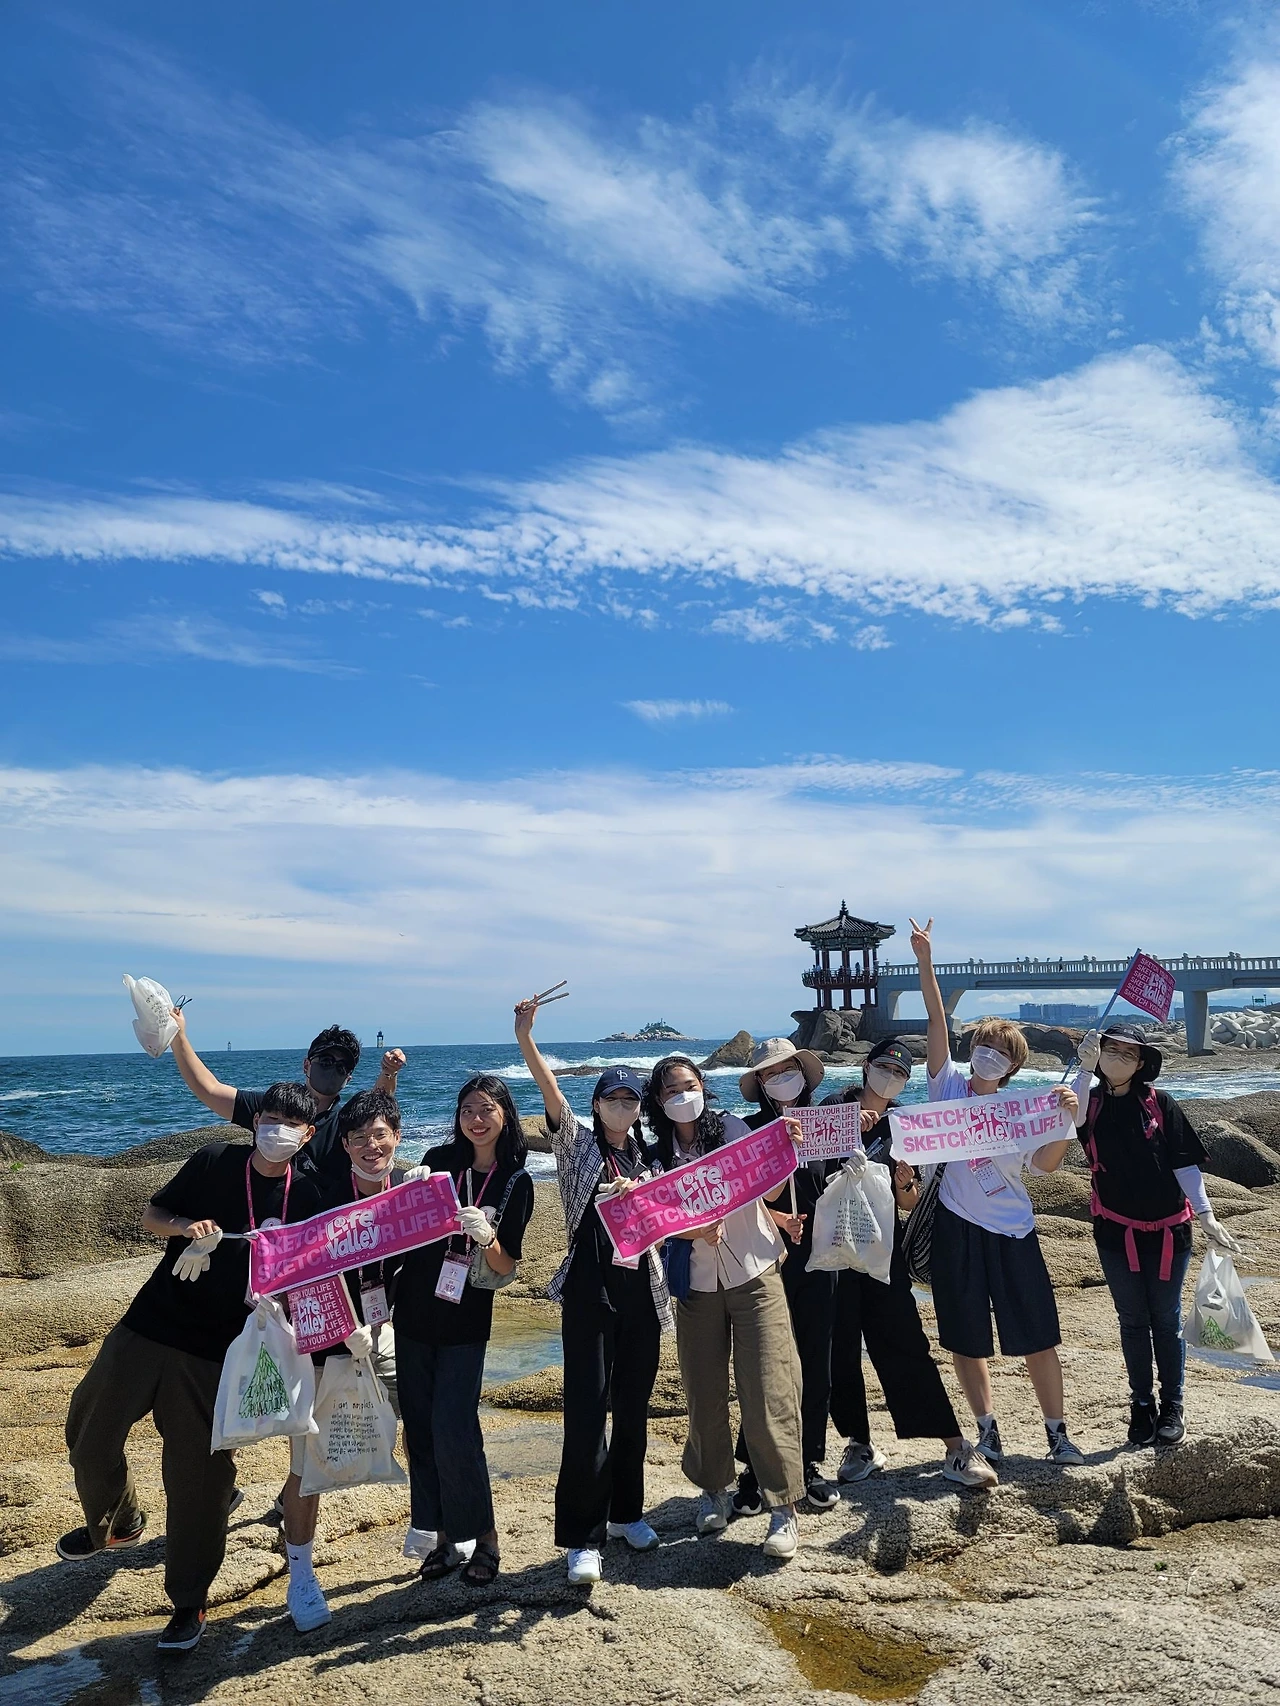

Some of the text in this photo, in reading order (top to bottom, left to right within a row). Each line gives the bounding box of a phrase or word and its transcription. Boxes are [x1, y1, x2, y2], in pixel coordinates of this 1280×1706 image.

[791, 1109, 820, 1117] SKETCH
[821, 1107, 840, 1116] YOUR
[841, 1105, 855, 1113] LIFE
[1024, 1094, 1057, 1115] LIFE
[809, 1115, 842, 1134] Life
[841, 1113, 855, 1121] LIFE
[841, 1120, 855, 1129] LIFE
[965, 1102, 1007, 1128] Life
[1029, 1114, 1058, 1136] LIFE
[809, 1128, 843, 1146] Valley
[841, 1129, 855, 1137] LIFE
[841, 1136, 856, 1145] LIFE
[964, 1121, 1013, 1146] Valley
[735, 1135, 775, 1168] LIFE
[797, 1148, 820, 1157] KETCH
[821, 1146, 840, 1155] YOUR
[745, 1155, 782, 1189] LIFE
[675, 1164, 724, 1201] Life
[394, 1185, 436, 1213] LIFE
[680, 1180, 732, 1219] Valley
[325, 1208, 376, 1240] Life
[398, 1208, 441, 1238] LIFE
[325, 1224, 381, 1260] Valley
[300, 1286, 317, 1297] YOUR
[316, 1282, 332, 1294] LIFE
[319, 1291, 335, 1303] LIFE
[297, 1296, 321, 1320] Life
[320, 1300, 338, 1313] LIFE
[325, 1317, 344, 1331] LIFE
[307, 1333, 328, 1345] YOUR
[329, 1325, 347, 1340] LIFE
